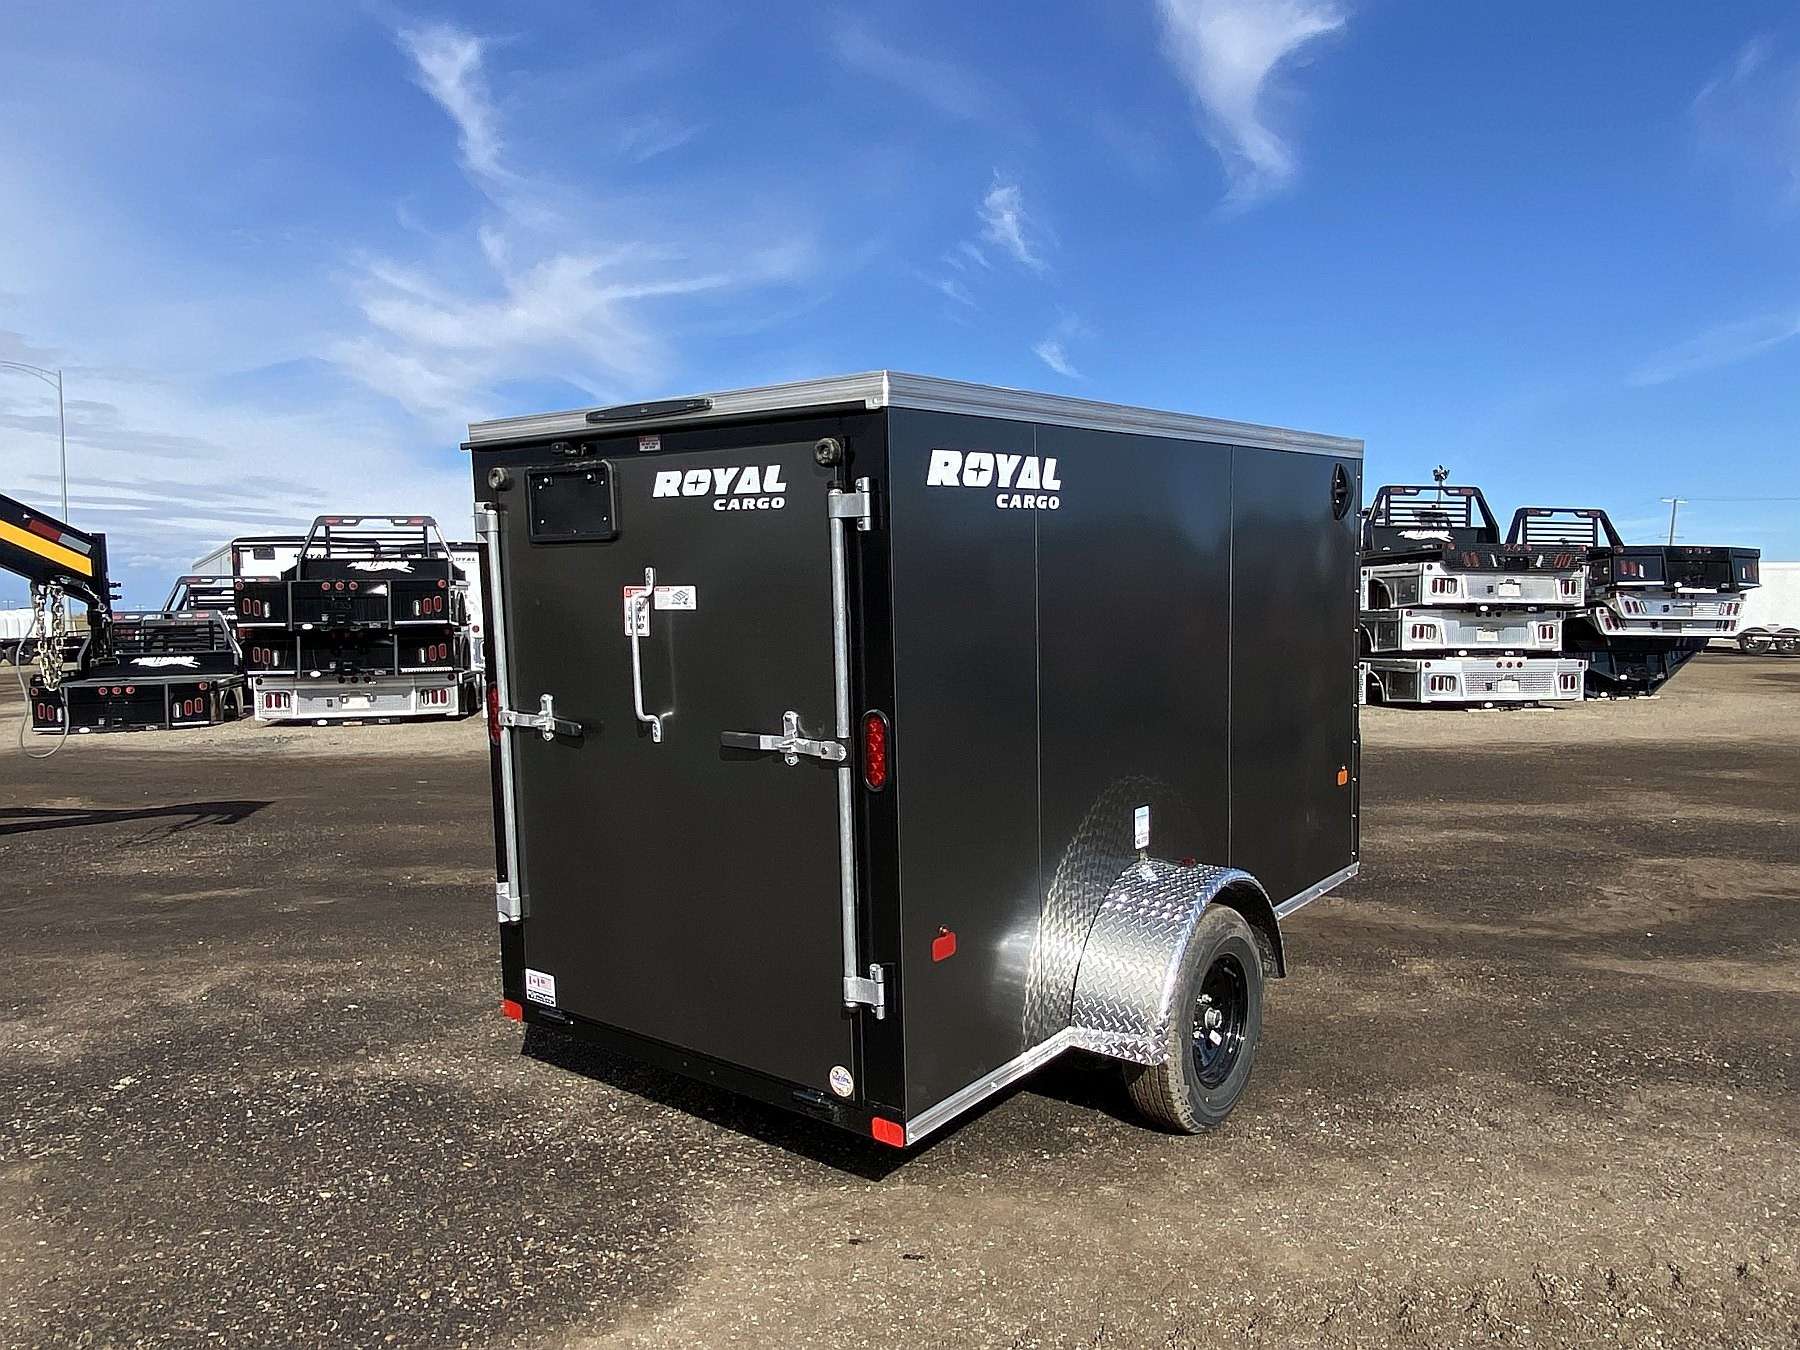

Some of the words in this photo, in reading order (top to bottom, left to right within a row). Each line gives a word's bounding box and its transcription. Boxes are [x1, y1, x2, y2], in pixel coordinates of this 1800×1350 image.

[652, 464, 787, 498] ROYAL
[926, 449, 1062, 491] ROYAL
[713, 496, 786, 511] CARGO
[996, 493, 1060, 510] CARGO
